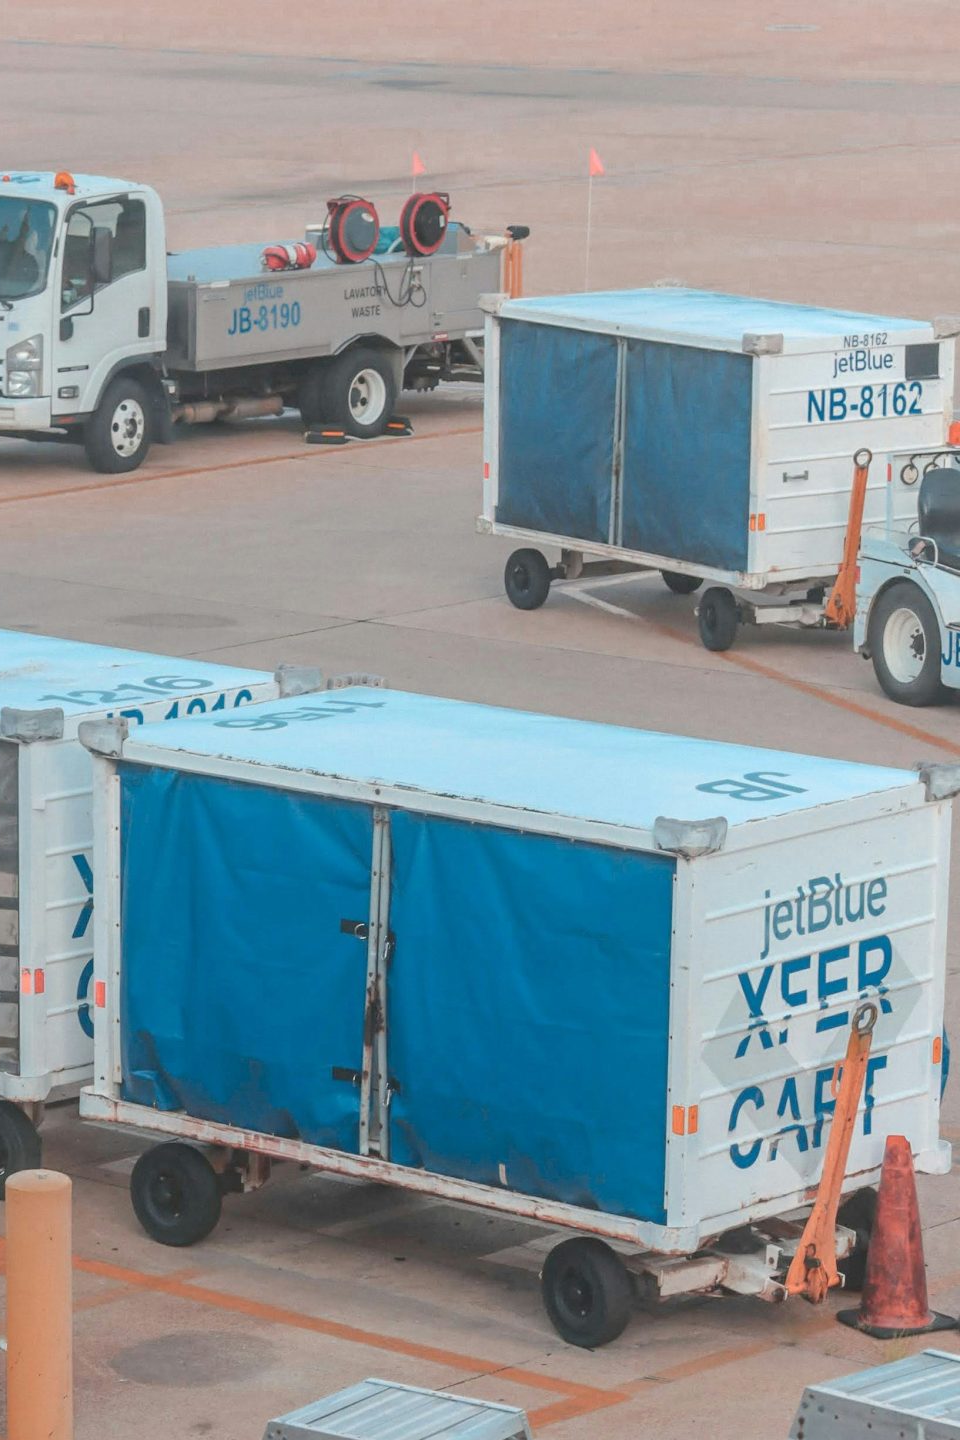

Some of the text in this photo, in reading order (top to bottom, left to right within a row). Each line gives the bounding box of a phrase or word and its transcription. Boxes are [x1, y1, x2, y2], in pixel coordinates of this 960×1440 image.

[243, 283, 284, 305] jetBlue
[344, 285, 387, 300] LAVATORY
[228, 301, 301, 336] JB-8190
[351, 305, 381, 318] WASTE
[843, 332, 888, 348] NB-8162
[832, 349, 894, 378] jetBlue
[807, 381, 923, 423] NB-8162
[38, 675, 214, 707] 1216
[695, 771, 809, 801] JB
[760, 872, 887, 960] jetBlue
[734, 934, 893, 1059] XFER
